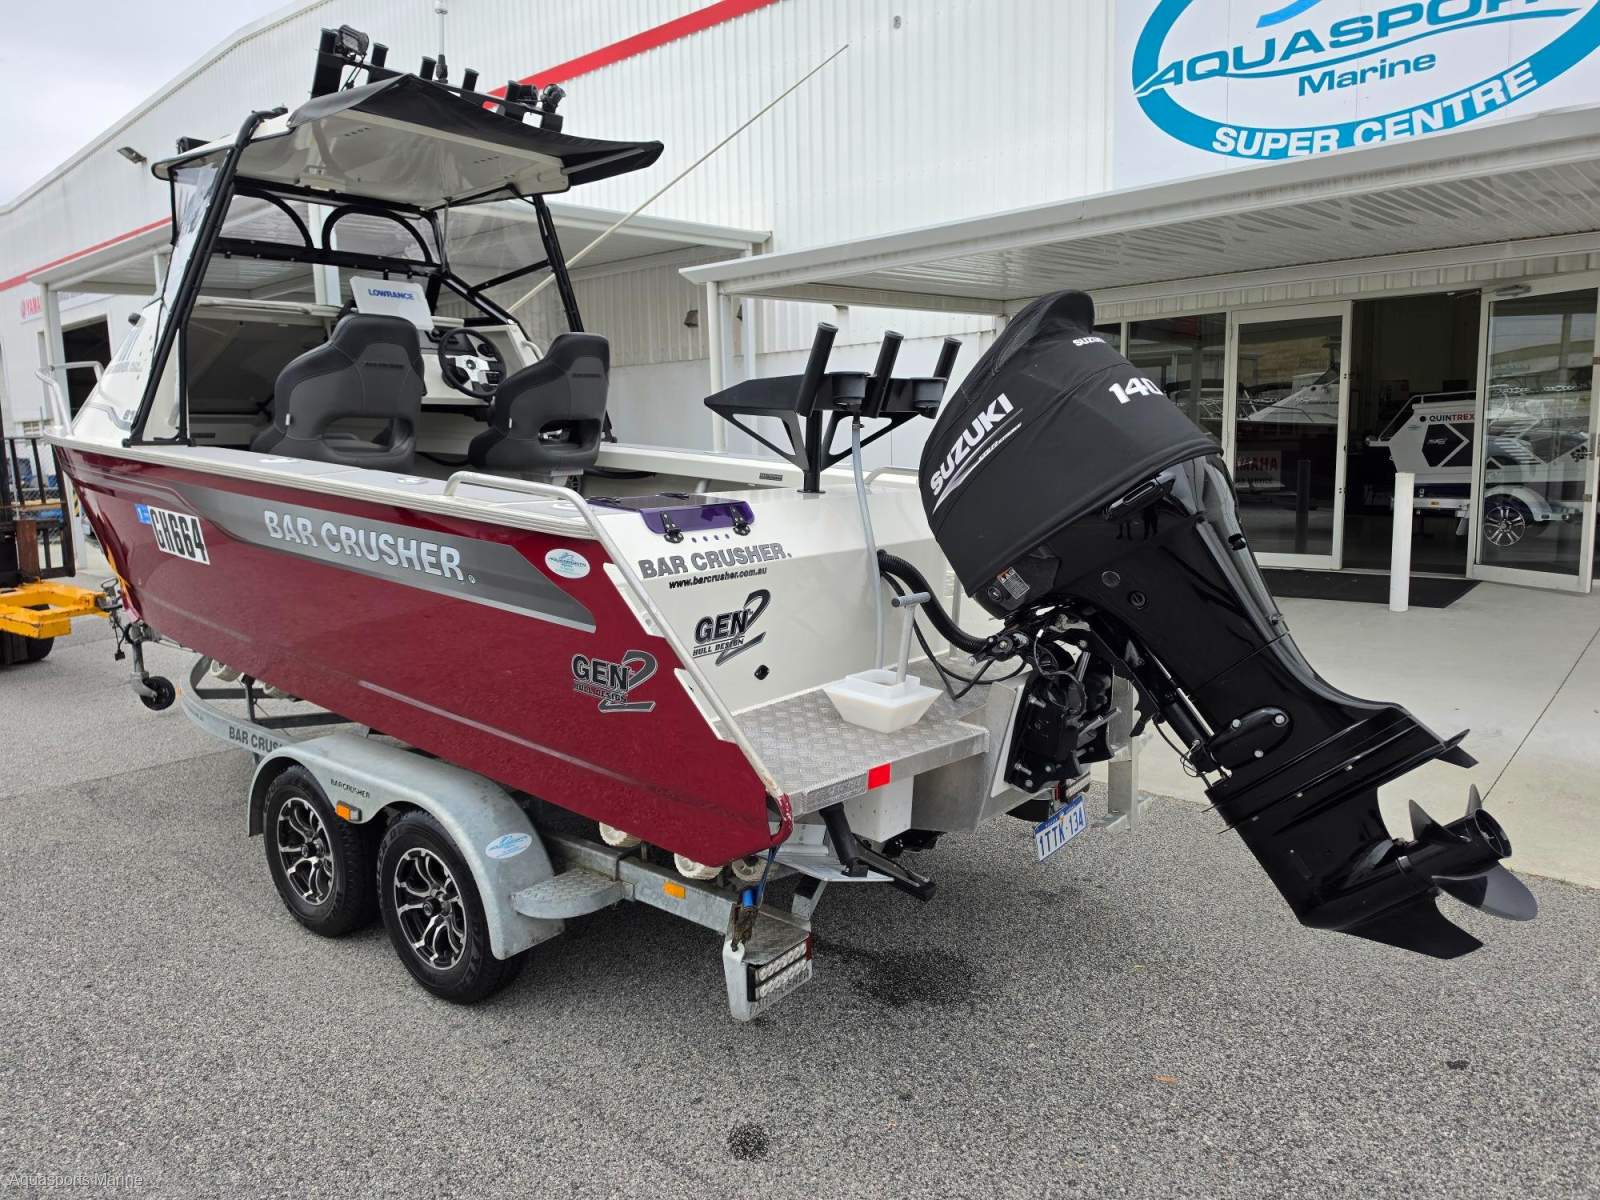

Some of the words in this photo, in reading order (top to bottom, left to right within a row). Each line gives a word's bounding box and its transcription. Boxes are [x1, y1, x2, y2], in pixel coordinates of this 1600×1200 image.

[1298, 52, 1437, 97] Marine
[1211, 126, 1340, 158] SUPER
[1352, 60, 1538, 149] CENTRE
[367, 288, 416, 301] LOWRANCE
[1108, 376, 1164, 405] 140
[1428, 413, 1476, 423] QUINTREX
[929, 392, 1015, 497] SUZUKI
[264, 510, 319, 548] BAR
[320, 521, 465, 582] CRUSHER
[638, 555, 689, 580] BAR
[668, 566, 768, 590] www.barcrusher.com.au
[695, 609, 750, 644] GEN
[692, 645, 713, 658] HULL
[571, 653, 630, 692] GEN
[228, 725, 249, 745] BAR
